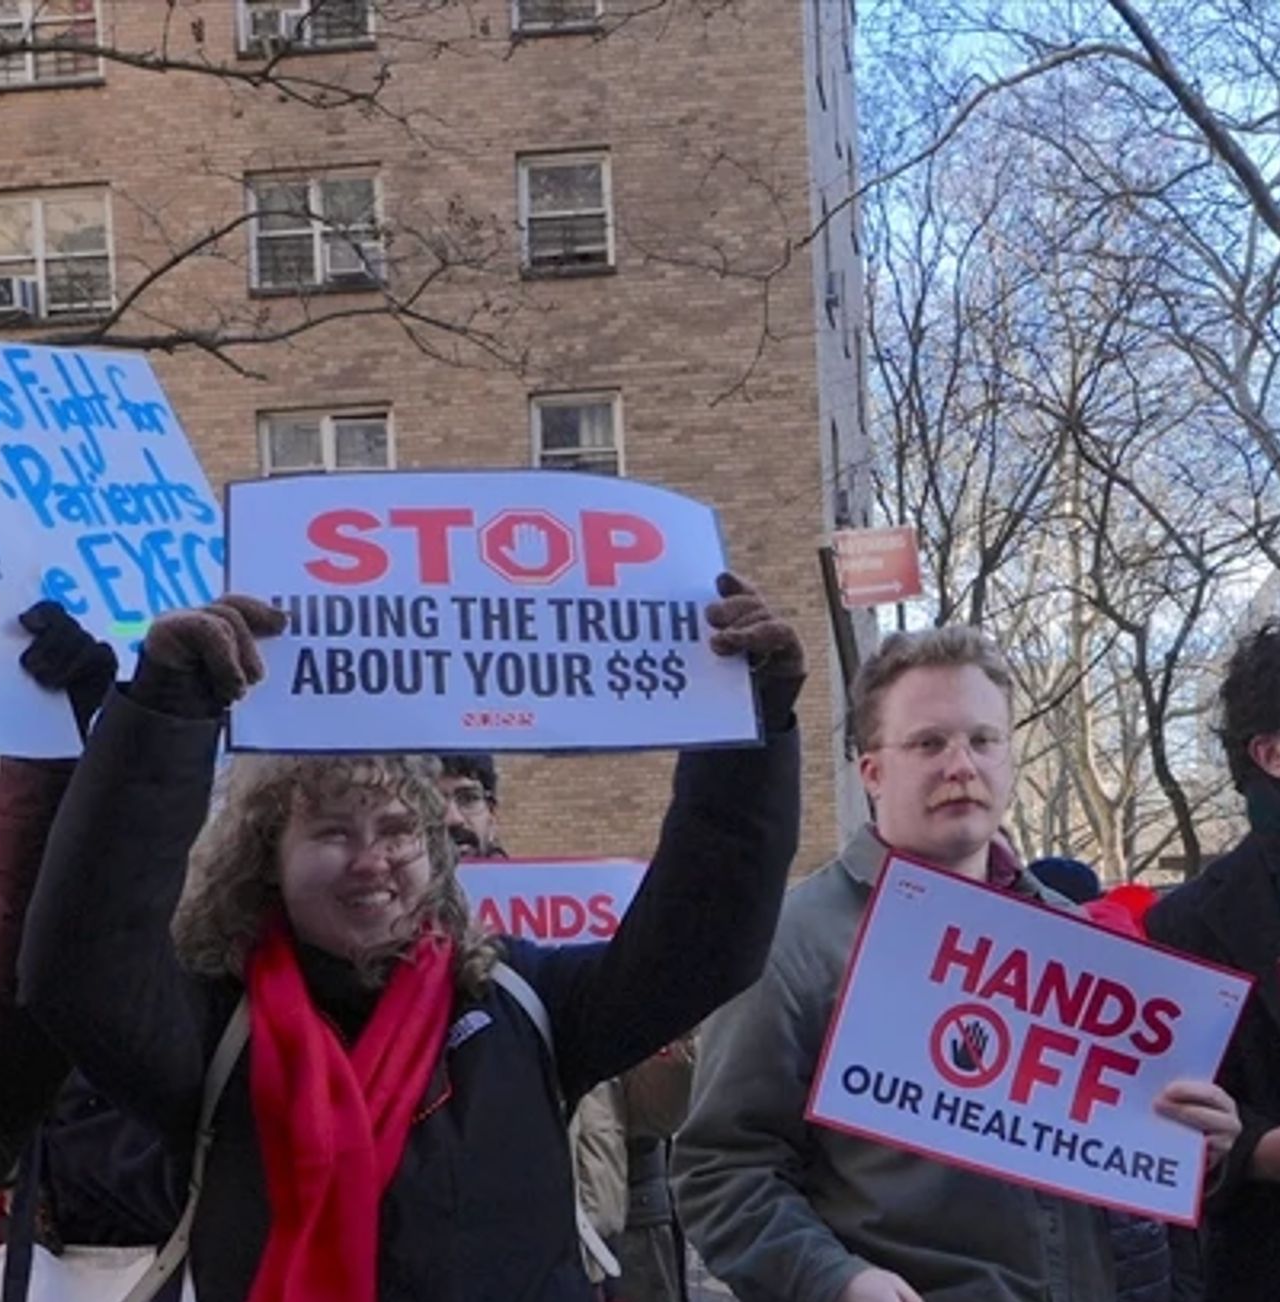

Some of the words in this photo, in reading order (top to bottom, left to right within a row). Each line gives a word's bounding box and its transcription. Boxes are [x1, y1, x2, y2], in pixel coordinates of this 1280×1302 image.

[1, 347, 117, 474] Fight
[105, 364, 169, 434] for
[0, 443, 216, 528] Patients
[304, 509, 664, 587] STOP
[271, 594, 439, 638] HIDING
[451, 596, 538, 641] THE
[547, 597, 699, 643] TRUTH
[291, 649, 451, 696] ABOUT
[463, 652, 594, 698] YOUR
[606, 650, 688, 699] $$$
[479, 892, 619, 940] ANDS
[930, 925, 1182, 1056] HANDS
[930, 1002, 1141, 1124] OFF
[841, 1064, 924, 1115] OUR
[932, 1091, 1181, 1188] HEALTHCARE
